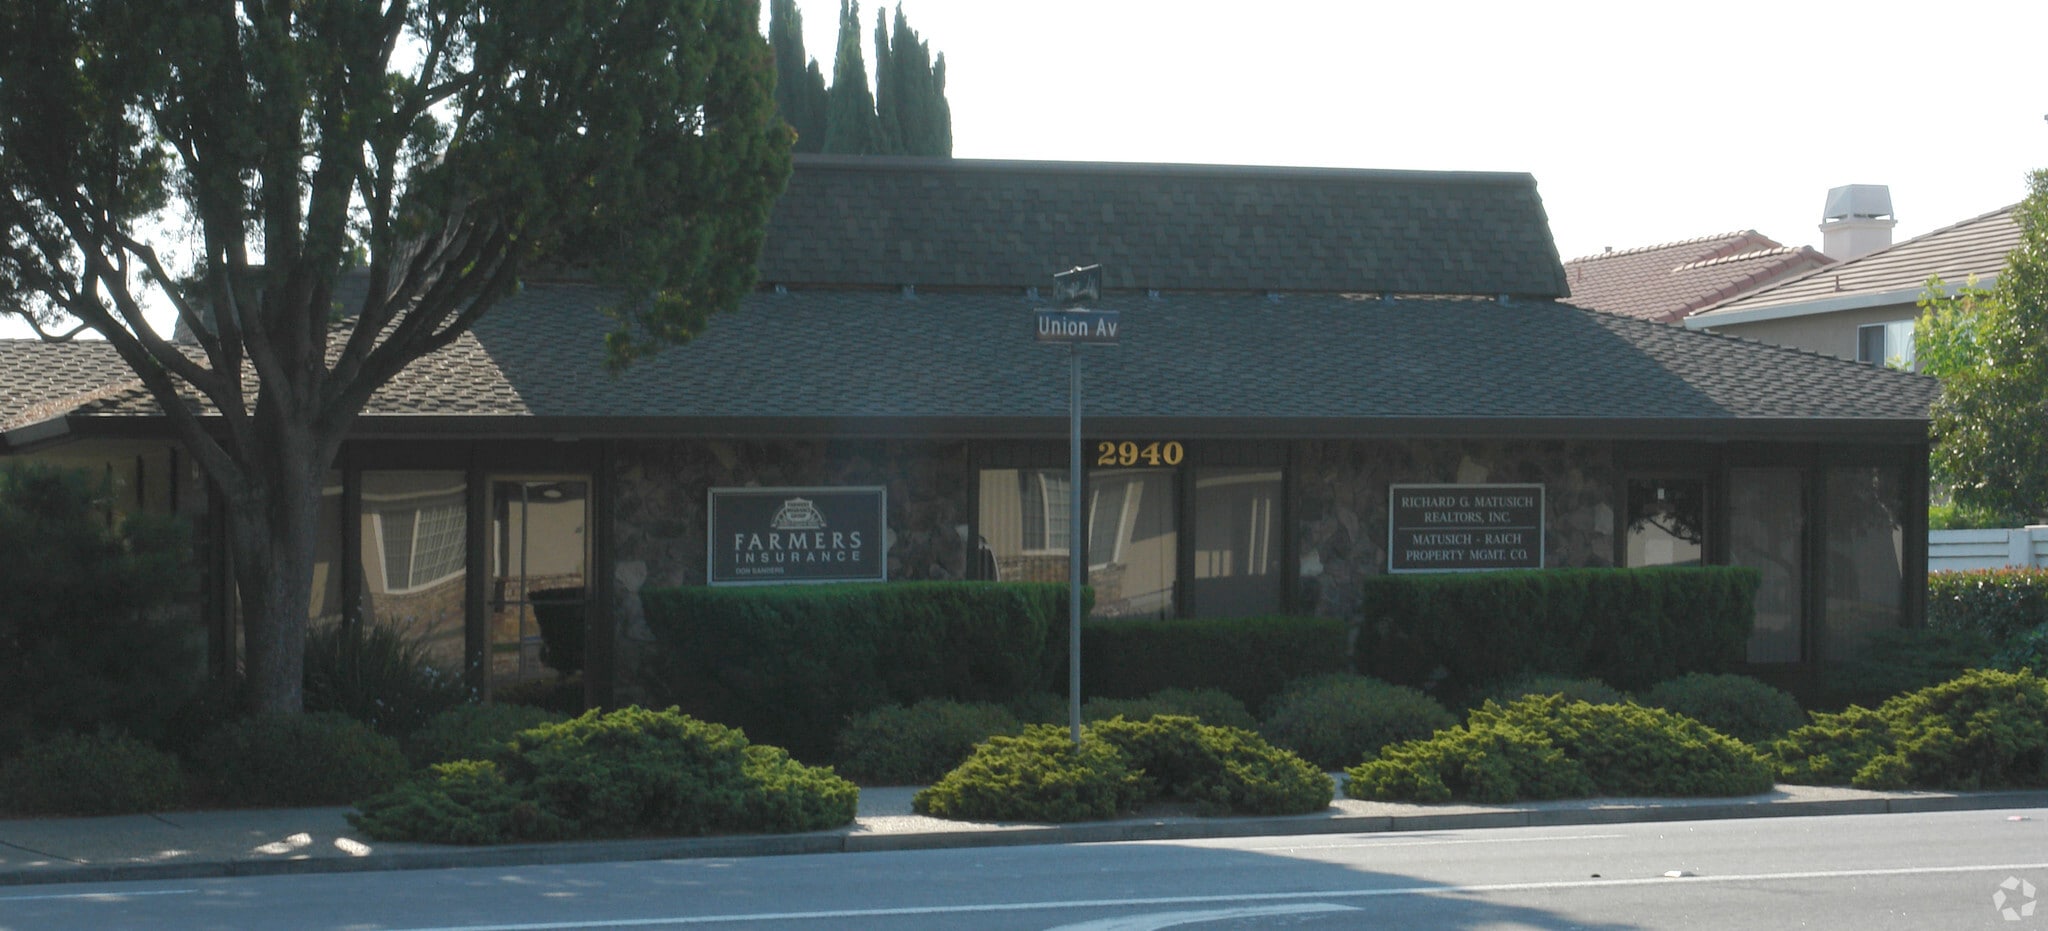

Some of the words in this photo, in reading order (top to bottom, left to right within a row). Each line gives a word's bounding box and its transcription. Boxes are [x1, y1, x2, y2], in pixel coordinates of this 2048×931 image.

[1039, 316, 1088, 336] Union
[1096, 317, 1117, 337] Av
[1097, 441, 1184, 466] 2940
[1401, 496, 1455, 508] RICHARD
[1474, 496, 1533, 507] MATUSICH
[1424, 511, 1485, 523] REALTORS,
[734, 531, 862, 551] FARMERS
[1412, 534, 1472, 545] MATUSICH
[1485, 533, 1521, 545] RAICH
[735, 550, 860, 563] INSURANCE
[1406, 549, 1464, 561] PROPERTY
